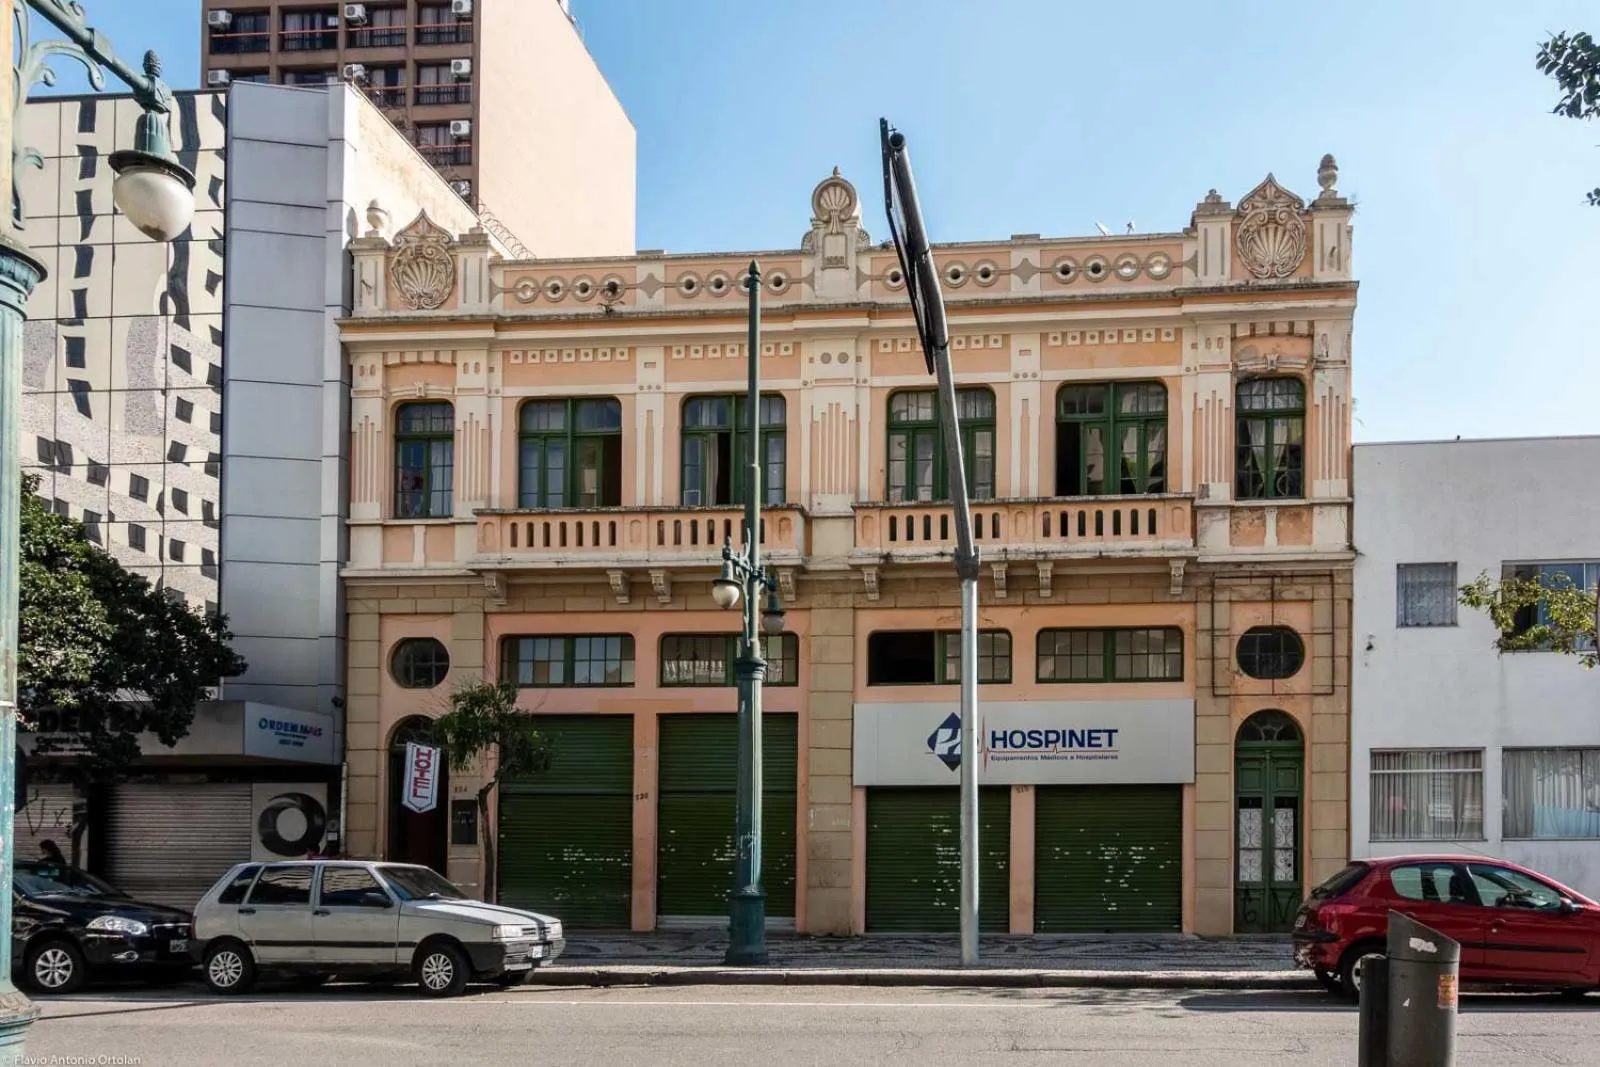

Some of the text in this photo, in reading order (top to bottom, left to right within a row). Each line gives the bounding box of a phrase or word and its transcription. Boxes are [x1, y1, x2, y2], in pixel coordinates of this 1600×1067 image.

[991, 729, 1118, 748] HOSPINET
[1076, 754, 1119, 762] Hospitalares
[412, 747, 432, 800] HOTEL
